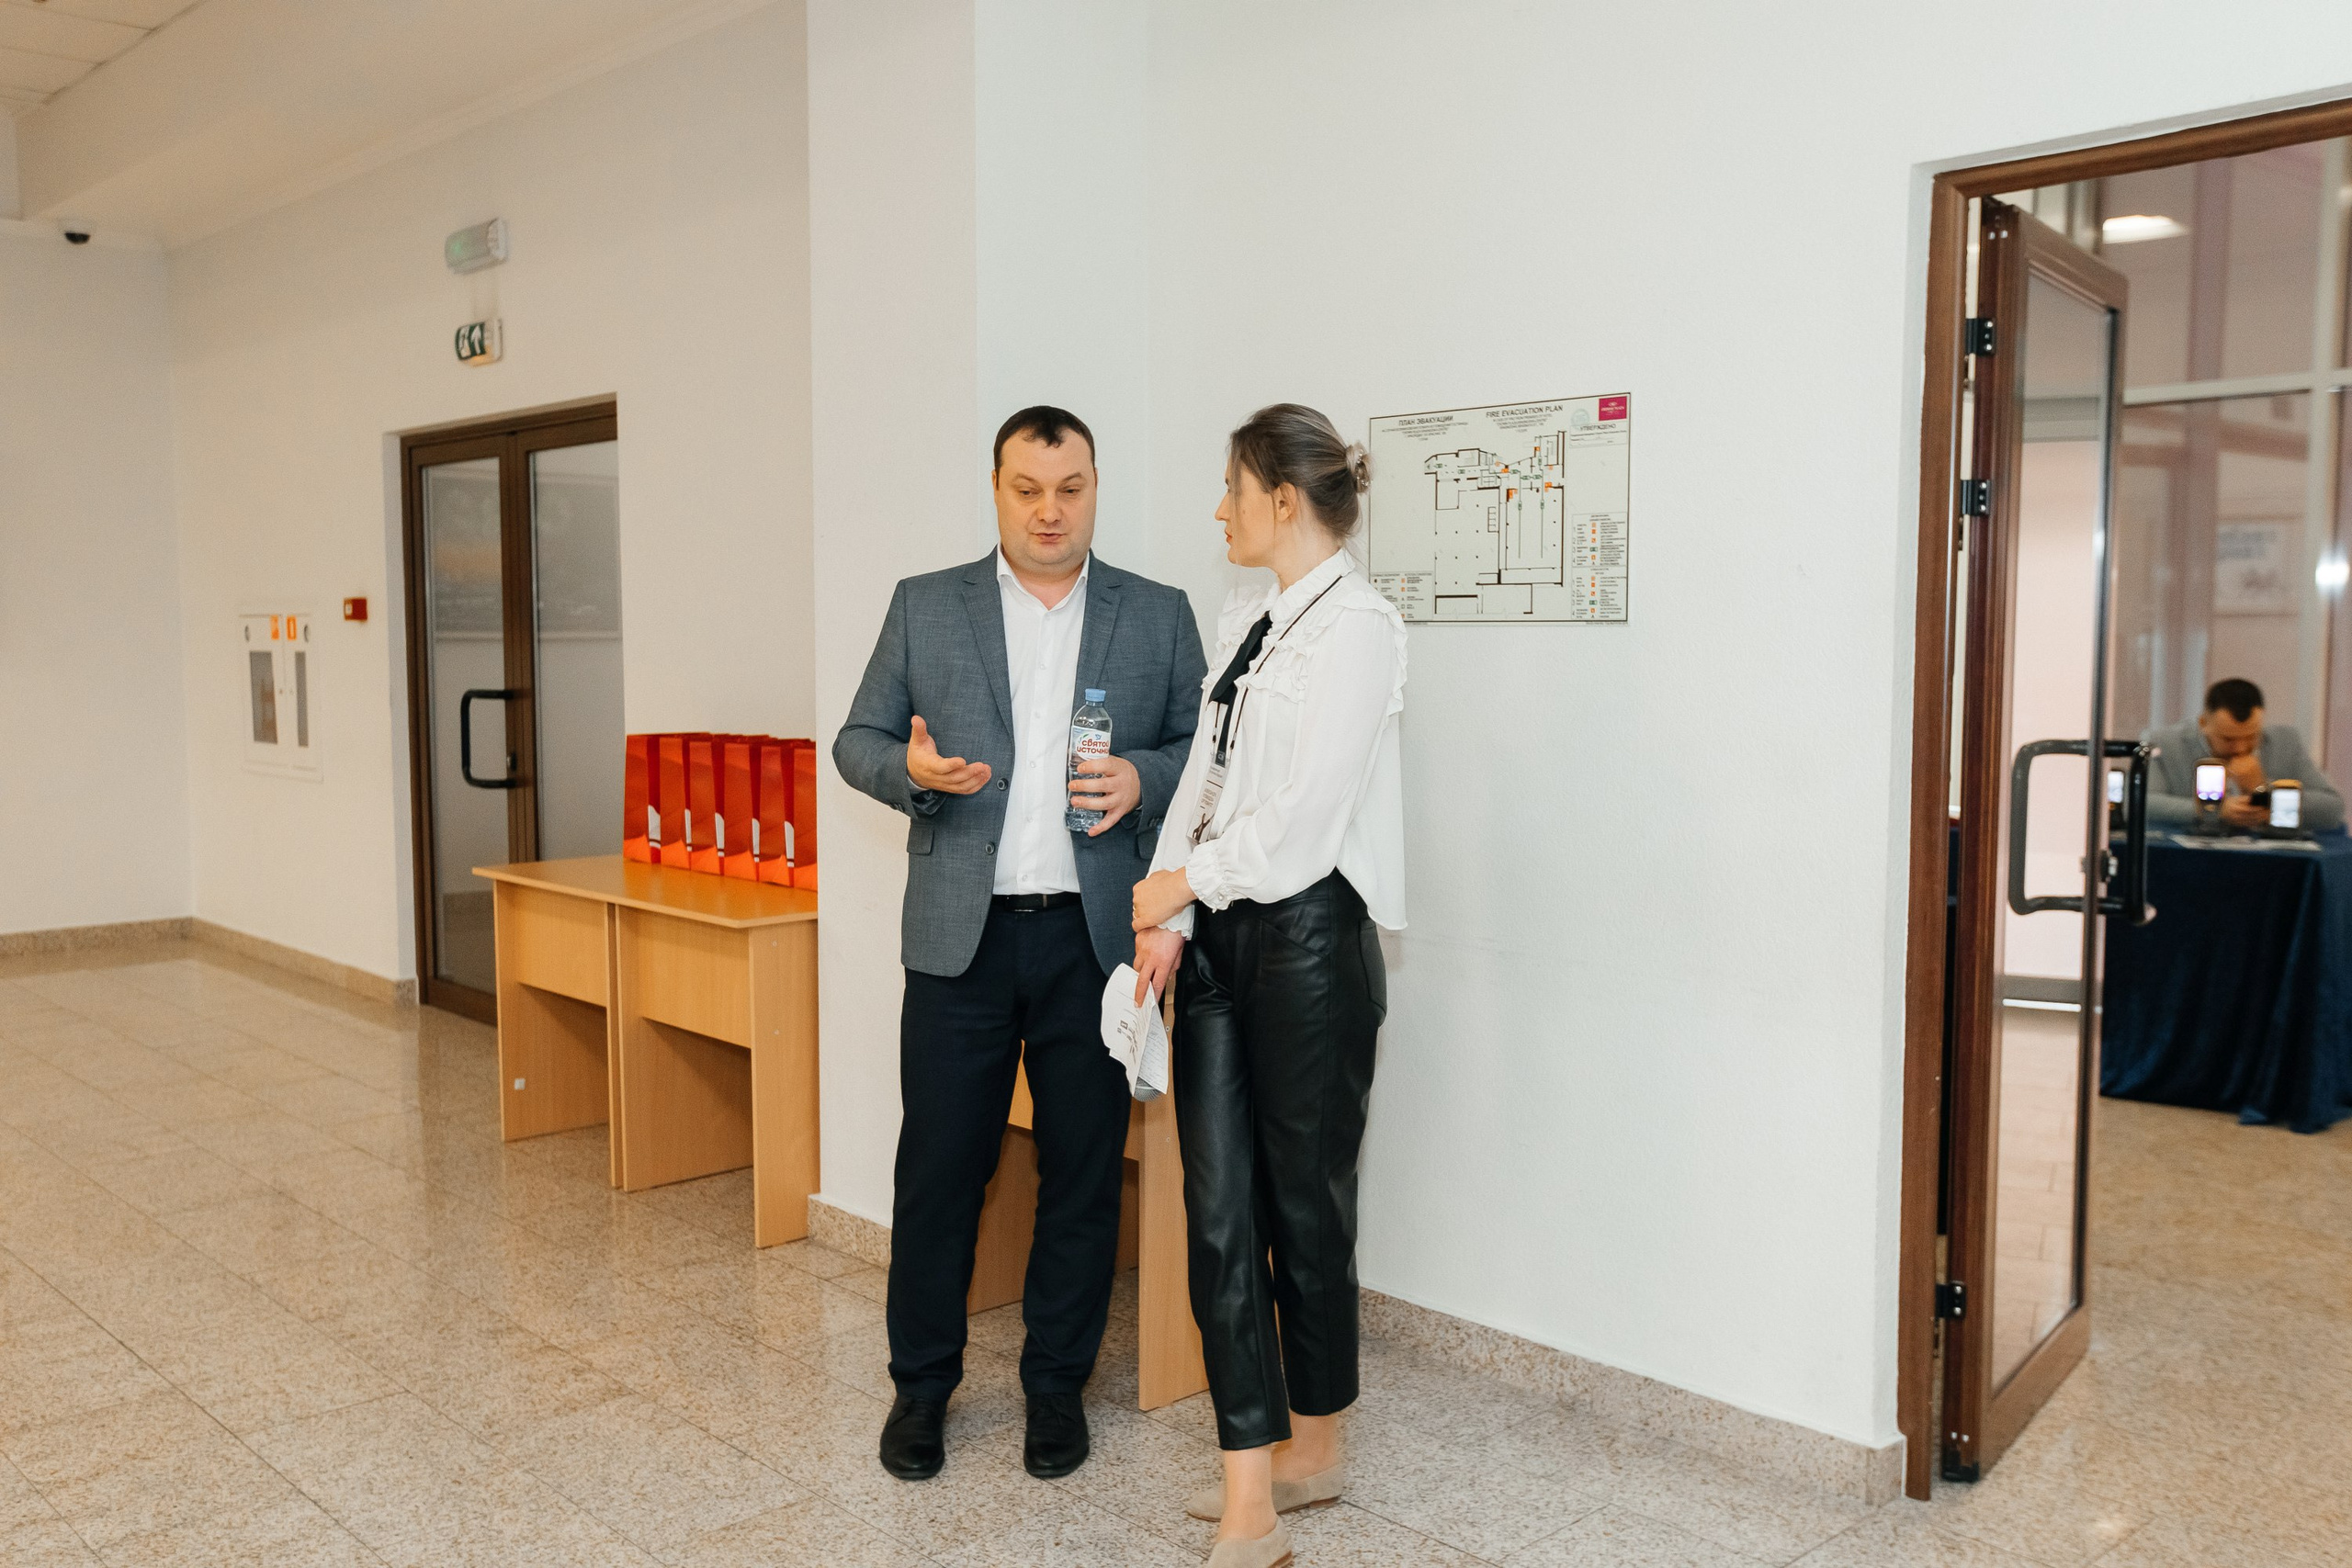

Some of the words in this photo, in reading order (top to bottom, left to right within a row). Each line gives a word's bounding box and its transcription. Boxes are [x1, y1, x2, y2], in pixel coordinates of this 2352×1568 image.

[1502, 407, 1544, 416] EVACUATION
[1545, 404, 1564, 412] PLAN
[1417, 415, 1453, 424] ЭВАКУАЦИИ
